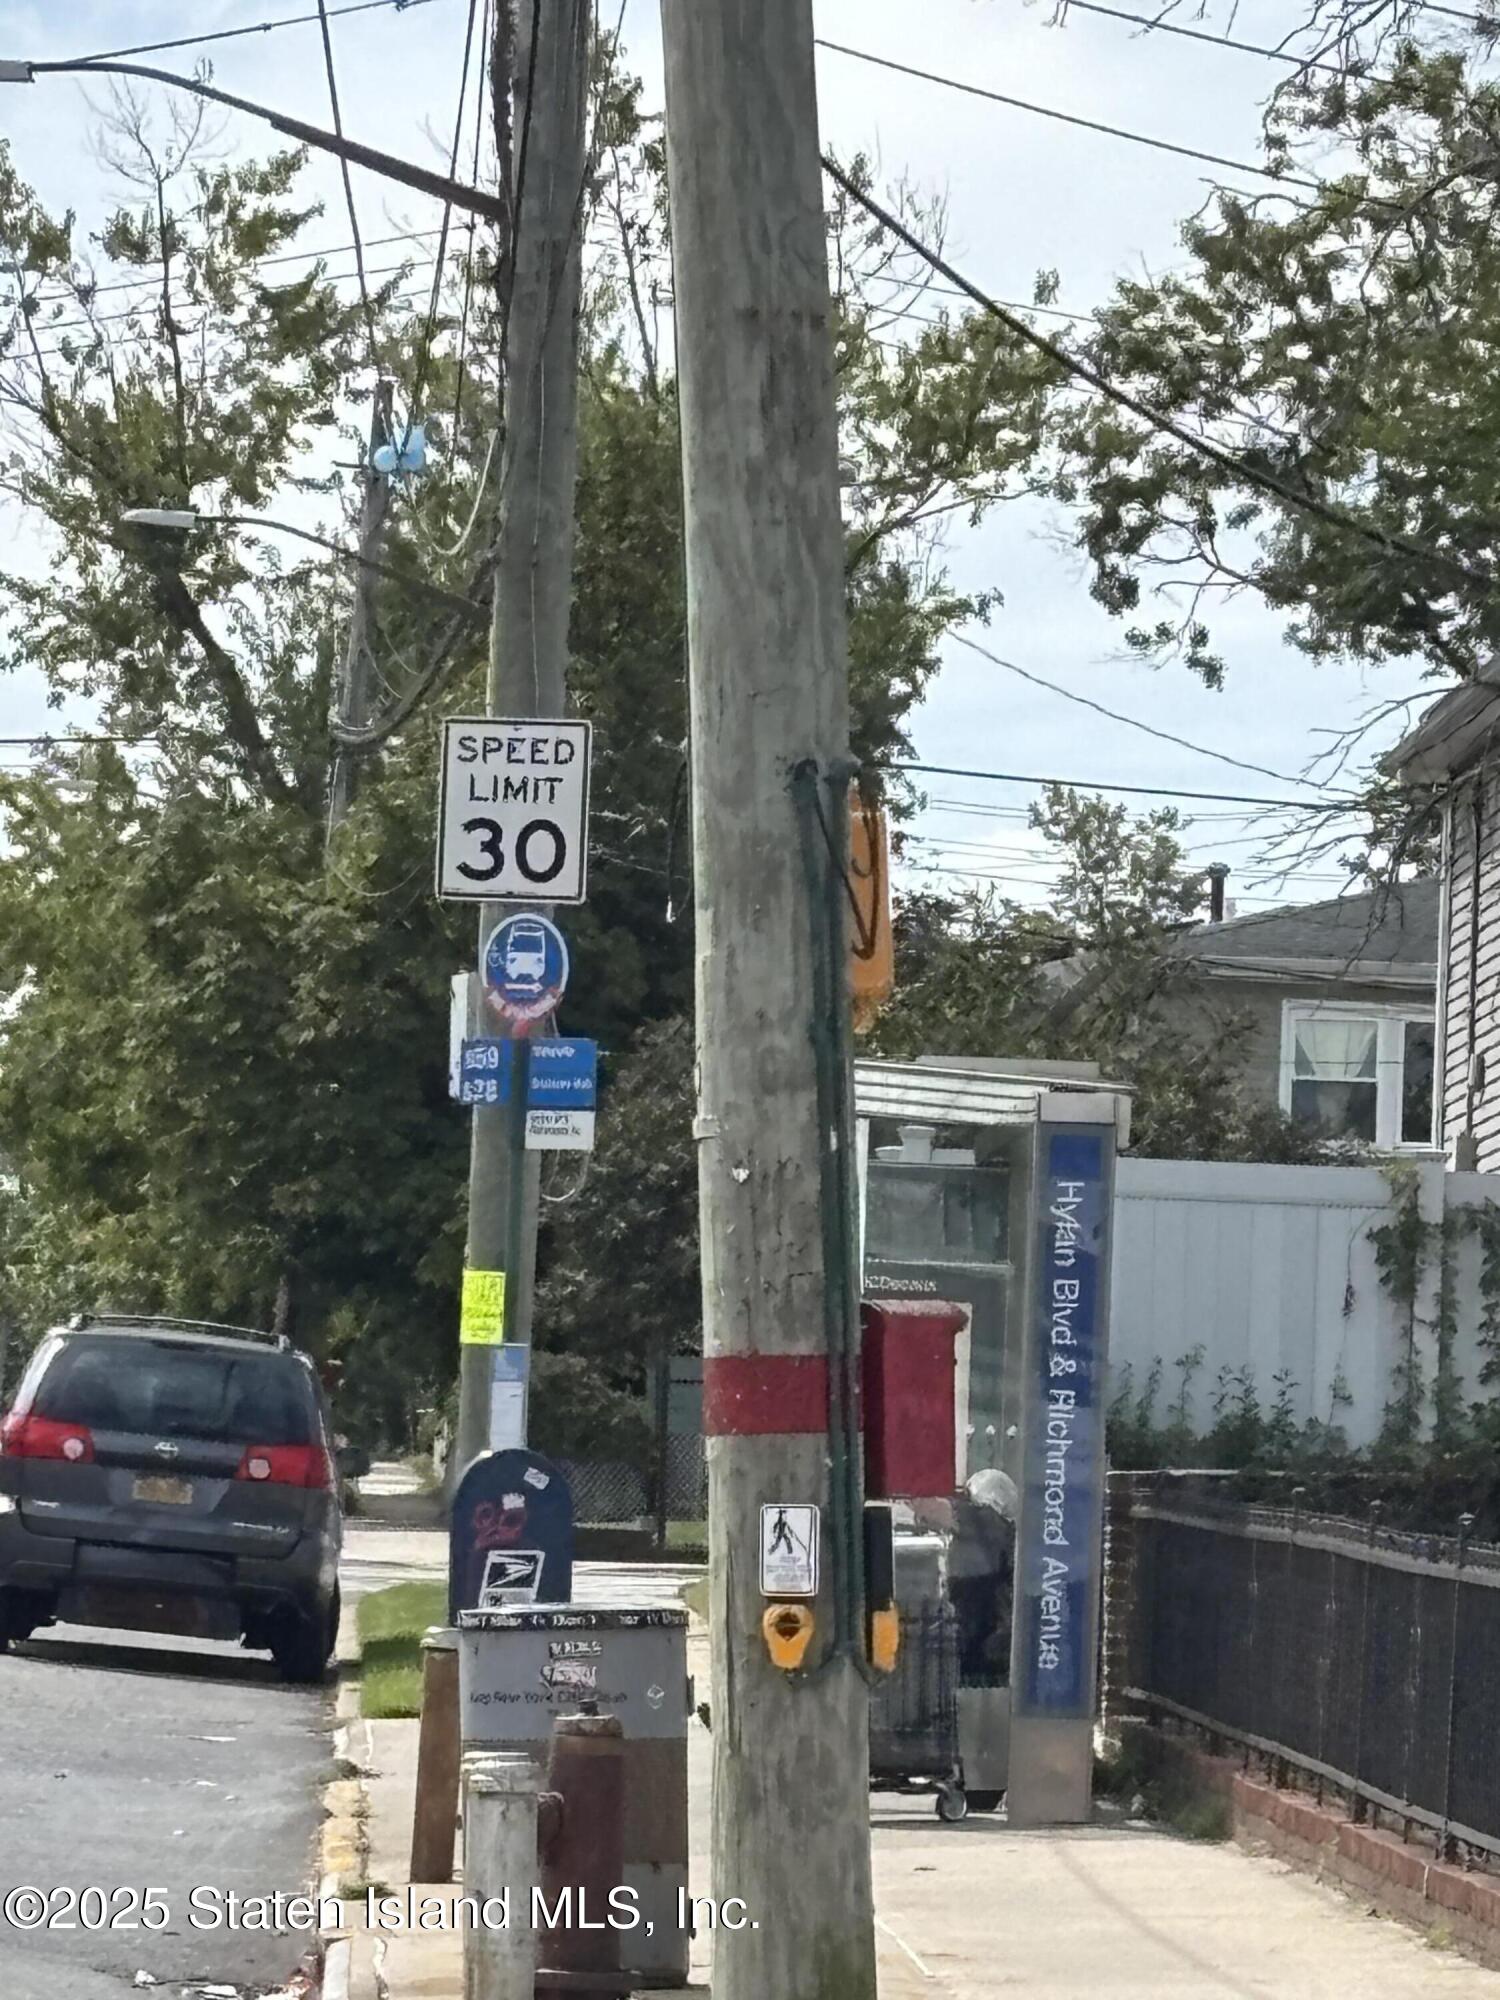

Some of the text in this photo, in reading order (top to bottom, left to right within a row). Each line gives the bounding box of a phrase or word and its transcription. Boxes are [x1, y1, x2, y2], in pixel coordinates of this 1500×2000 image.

[457, 735, 575, 764] SPEED
[469, 773, 563, 804] LIMIT
[456, 818, 567, 883] 30
[1037, 1181, 1084, 1669] Hylan Blvd & Richmond Avenue
